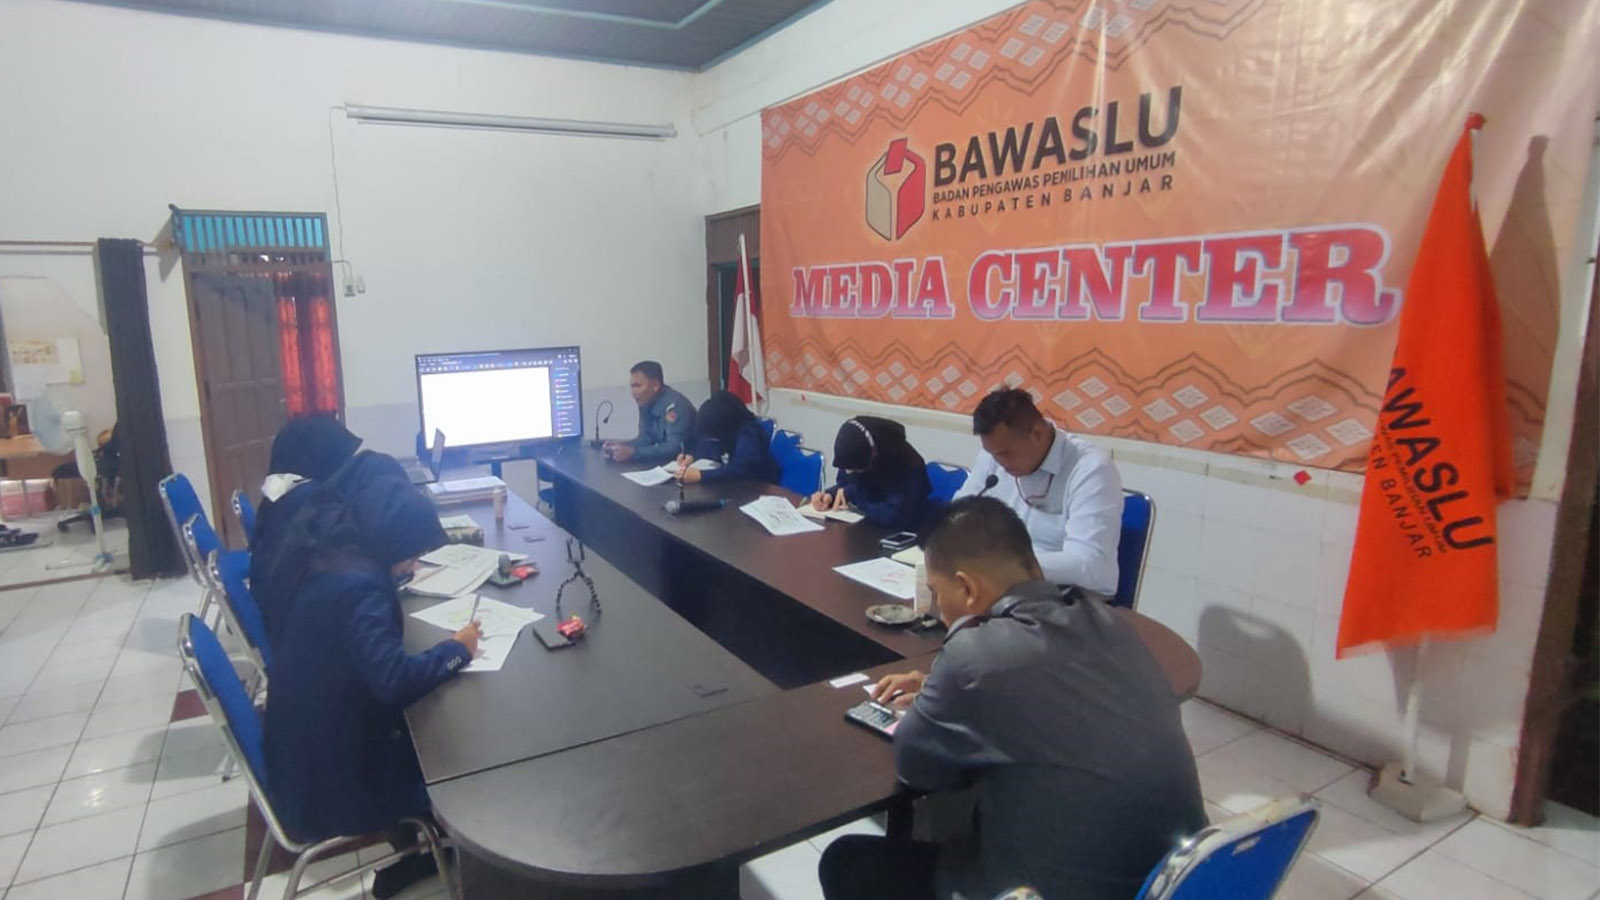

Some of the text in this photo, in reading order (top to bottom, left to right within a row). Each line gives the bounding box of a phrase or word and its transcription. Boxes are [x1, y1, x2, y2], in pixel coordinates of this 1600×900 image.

[933, 150, 1176, 204] BADAN PENGAWAS PEMILIHAN UMUM
[934, 86, 1182, 188] BAWASLU
[932, 174, 1174, 221] KABUPATEN BANJAR
[790, 223, 1402, 326] MEDIA CENTER
[1380, 478, 1432, 559] BANJAR
